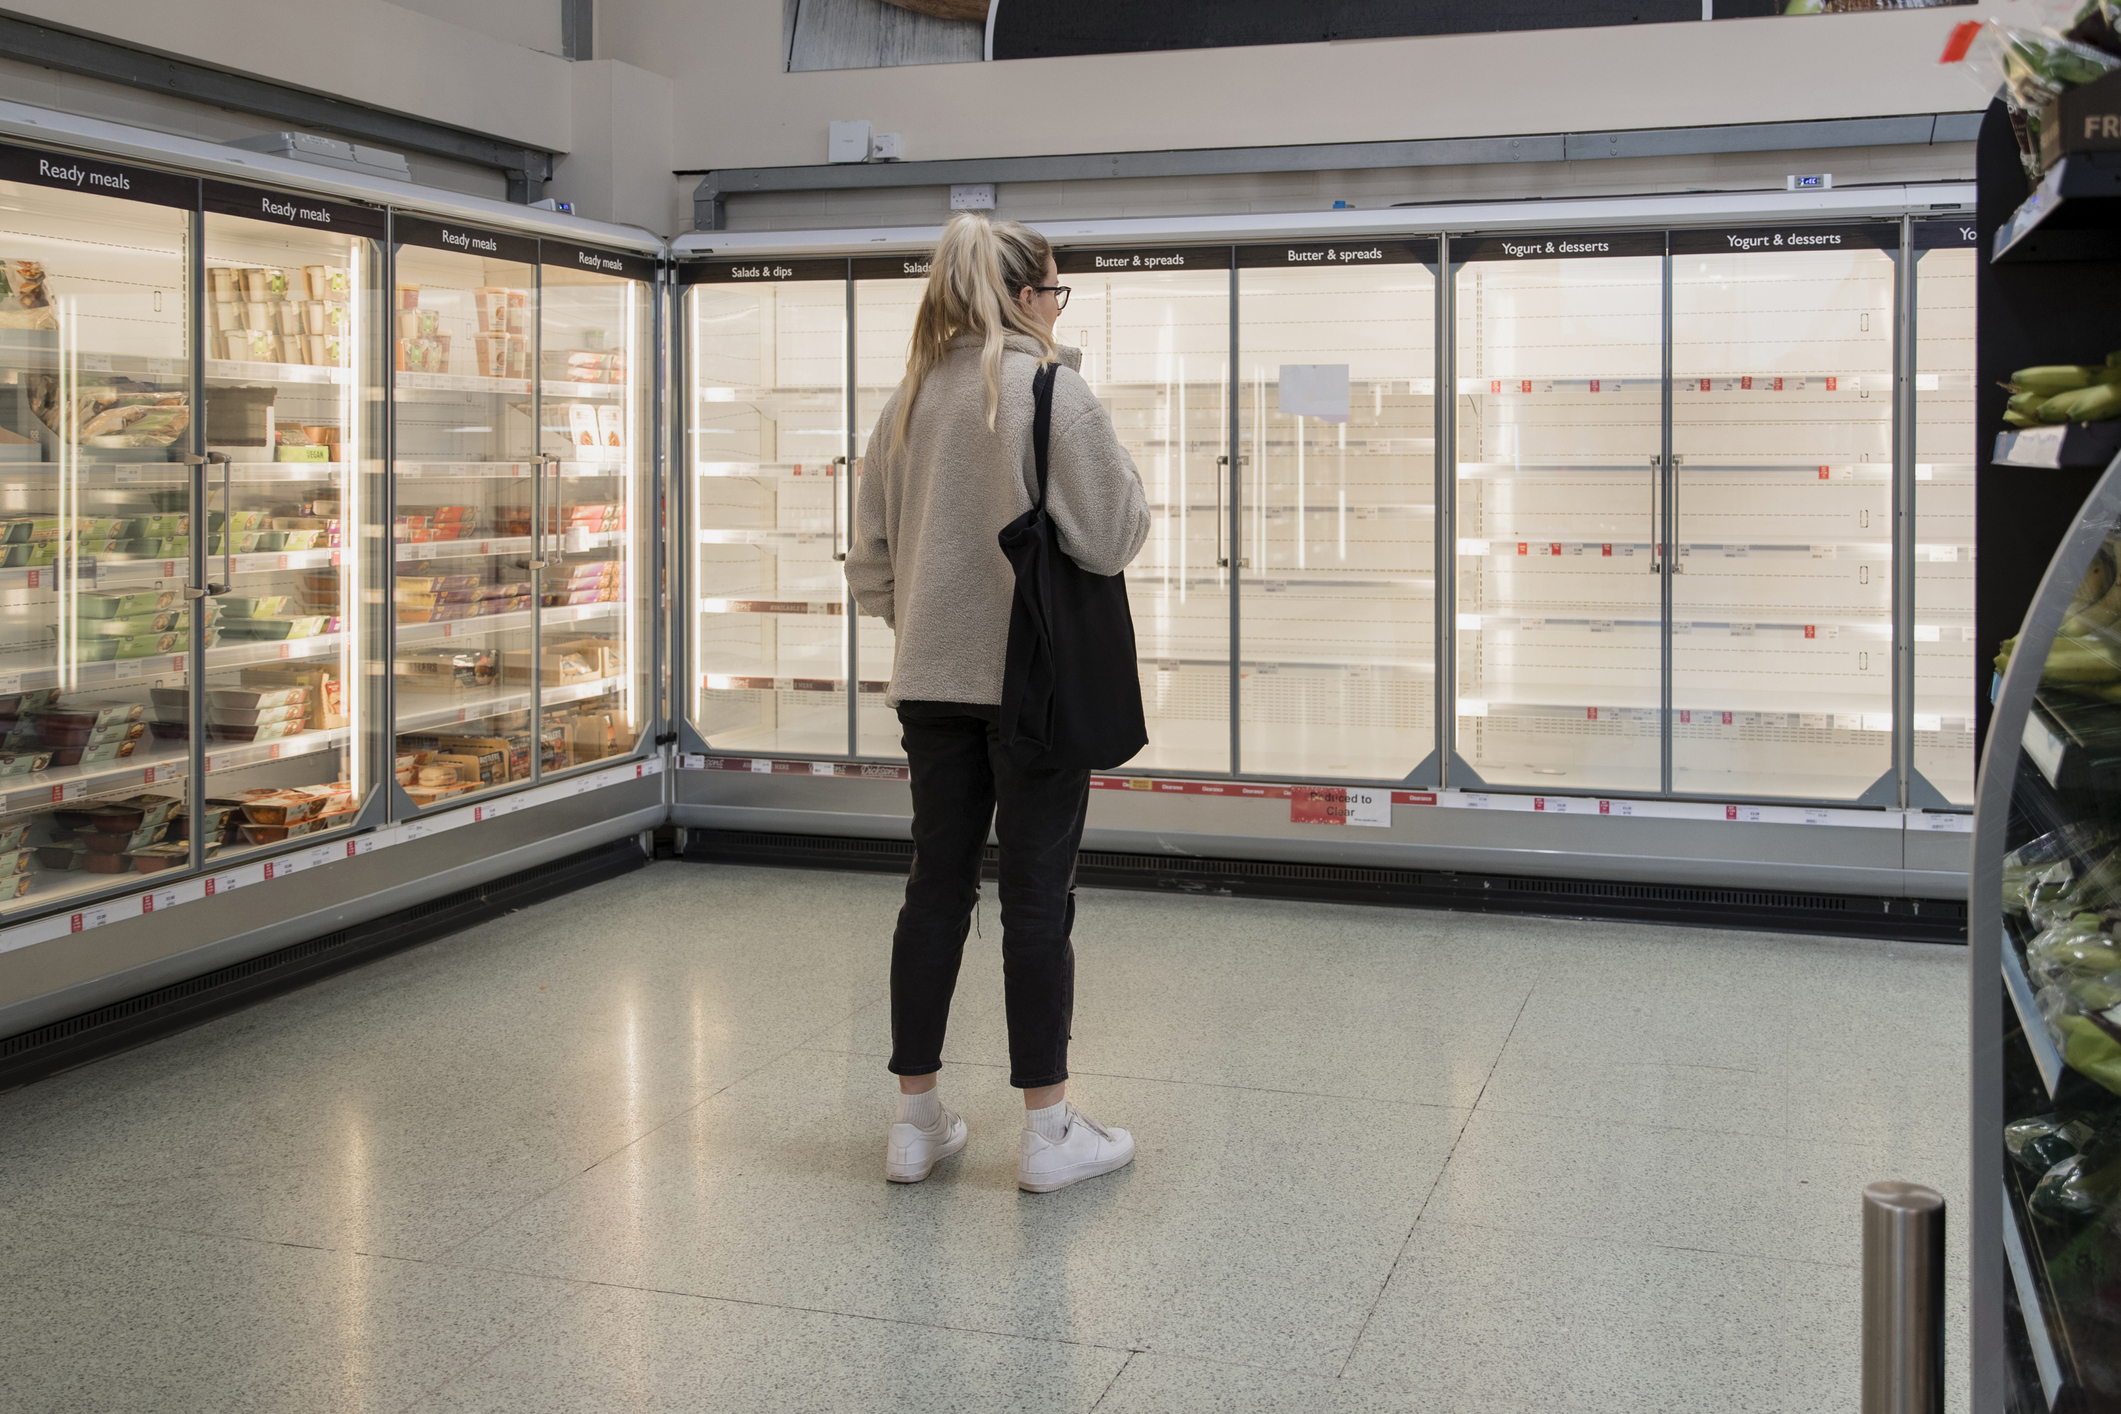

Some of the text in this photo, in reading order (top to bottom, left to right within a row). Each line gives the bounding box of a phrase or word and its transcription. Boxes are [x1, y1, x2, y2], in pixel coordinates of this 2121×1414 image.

[2083, 115, 2121, 140] FR
[39, 160, 130, 190] Ready meals
[262, 197, 331, 224] Ready meals
[442, 229, 497, 252] Ready meals
[1726, 233, 1841, 250] Yogurt & desserts
[1288, 248, 1382, 262] Butter & spreads
[1502, 240, 1609, 257] Yogurt & desserts
[579, 251, 623, 271] Ready meals
[1096, 254, 1184, 268] Butter & spreads
[731, 266, 792, 279] Salads & dips
[306, 450, 324, 459] VEGAN
[408, 662, 438, 673] STLERS
[861, 764, 899, 778] Dicksons
[1310, 791, 1372, 804] Reduced to
[1326, 806, 1355, 817] Clear
